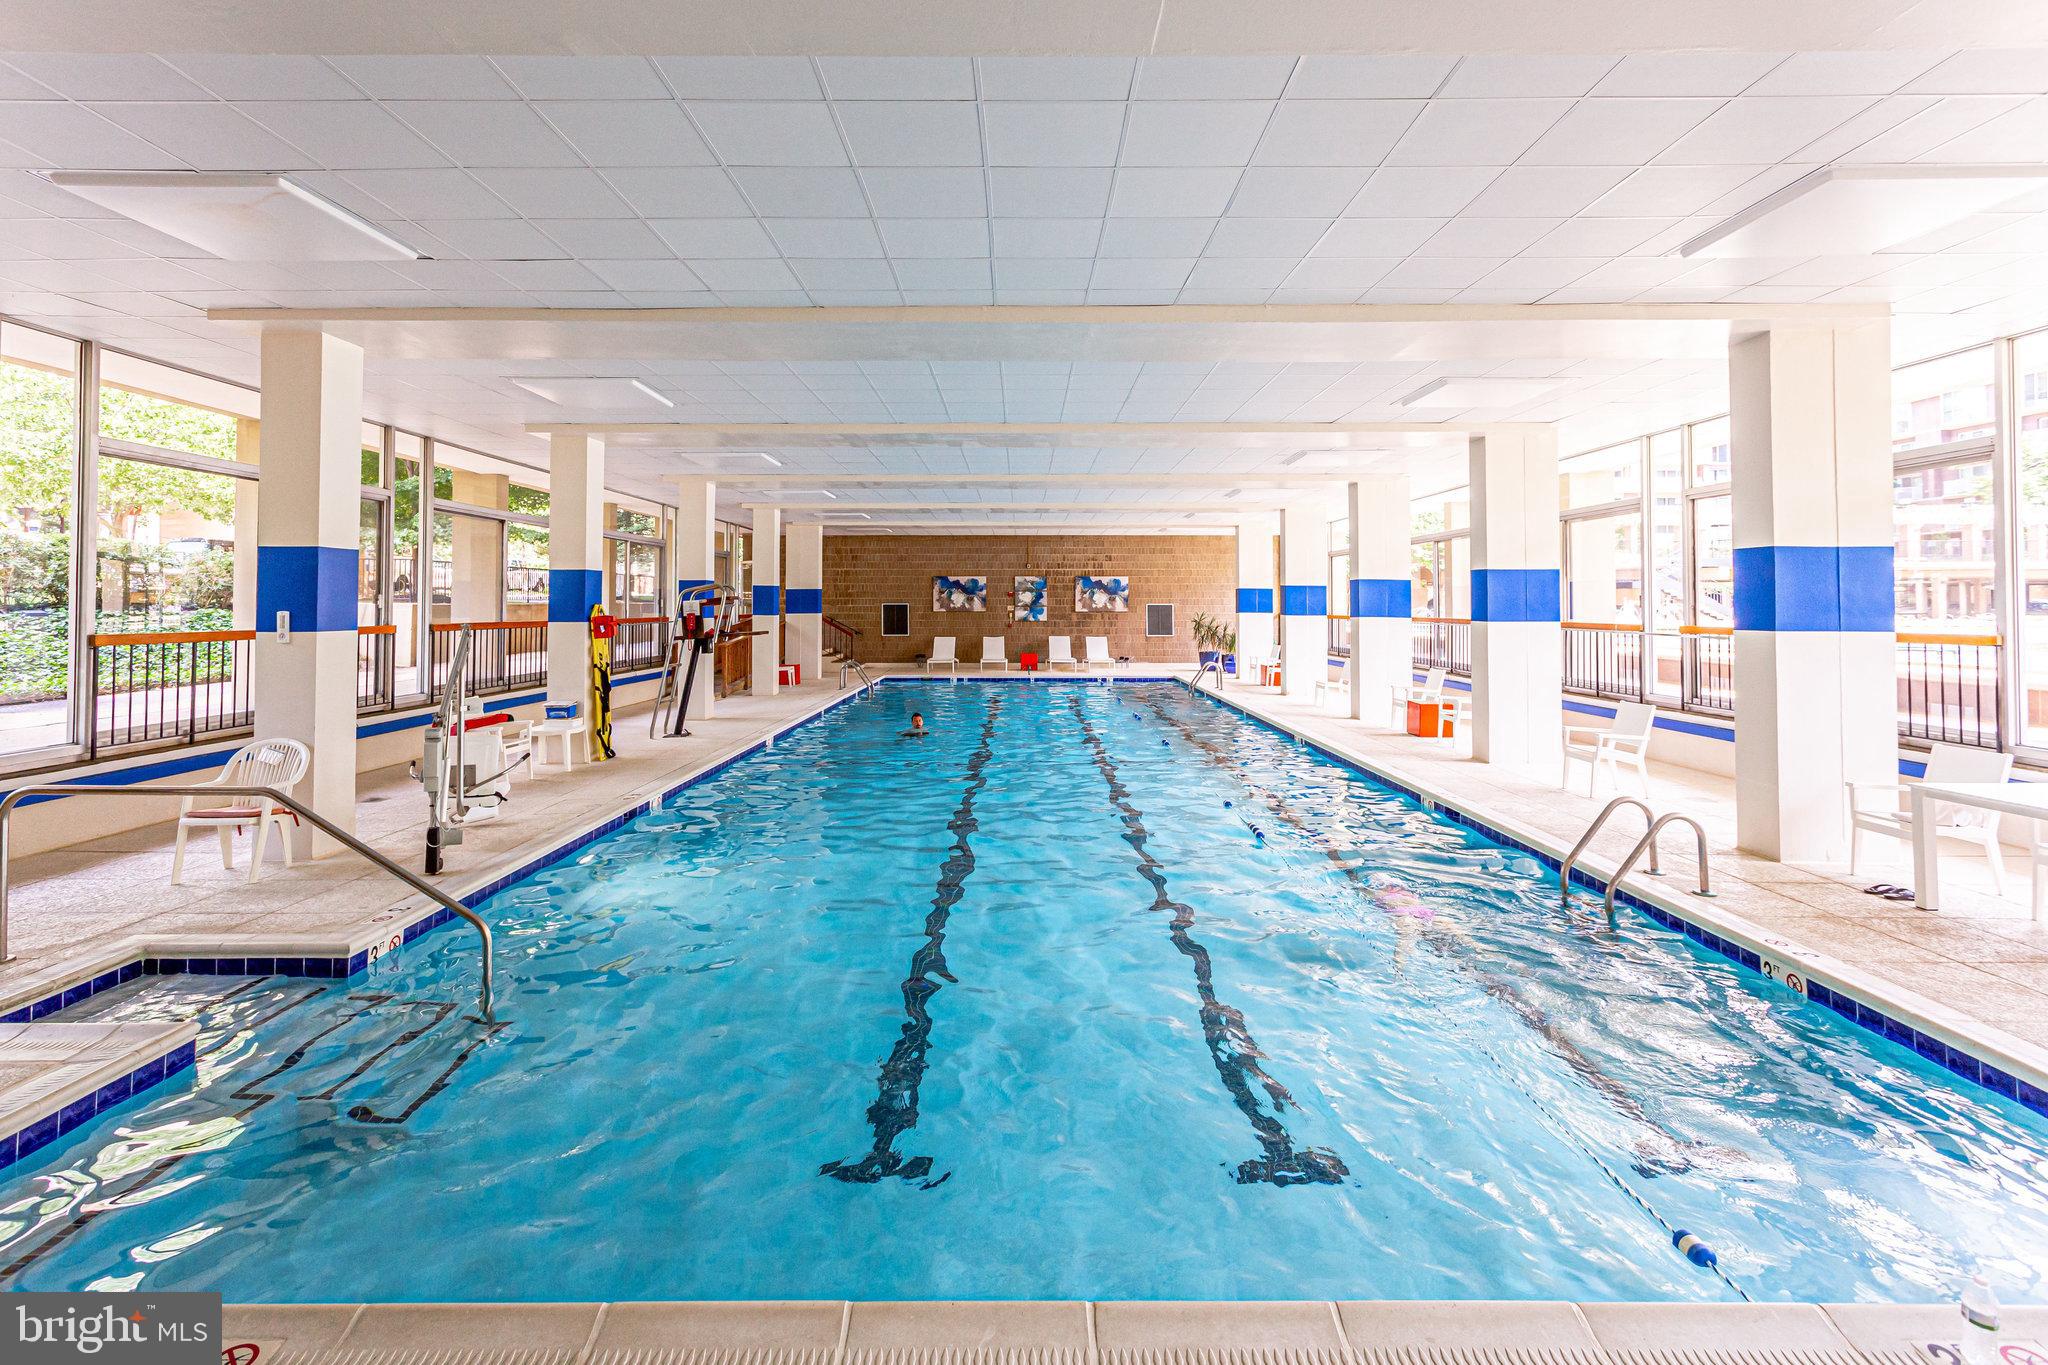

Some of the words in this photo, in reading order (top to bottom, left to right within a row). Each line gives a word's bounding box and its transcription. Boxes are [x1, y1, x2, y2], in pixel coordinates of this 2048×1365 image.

[370, 945, 379, 965] 3
[1763, 960, 1773, 980] 3
[1773, 964, 1780, 974] FT
